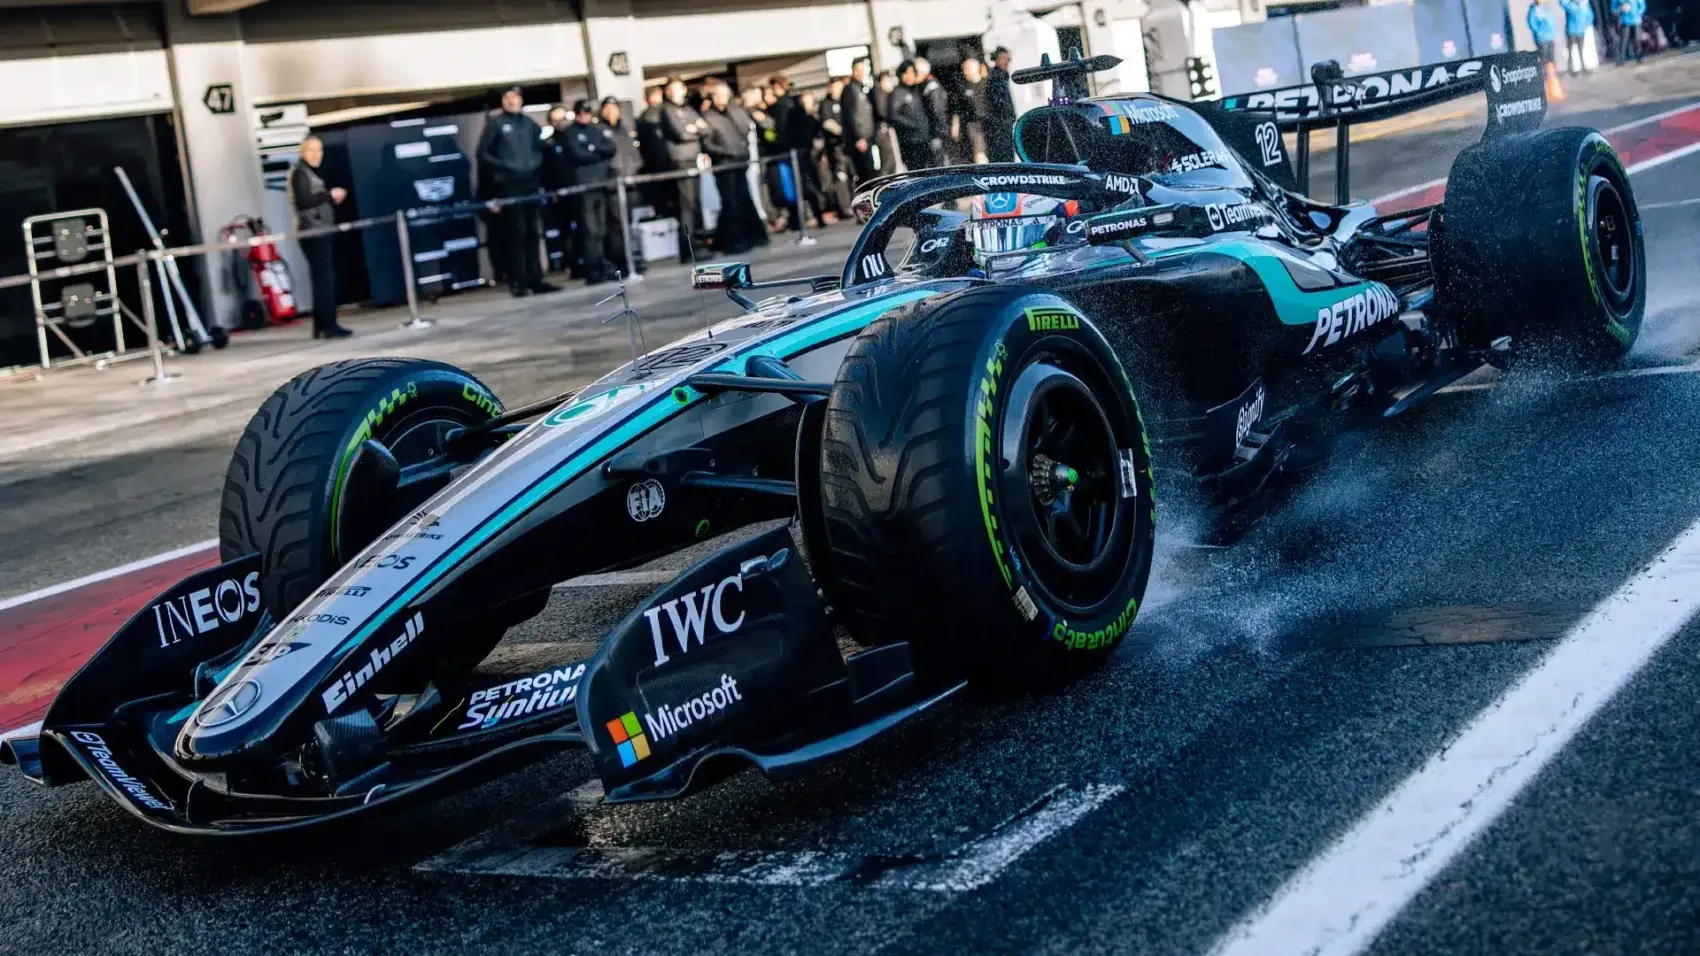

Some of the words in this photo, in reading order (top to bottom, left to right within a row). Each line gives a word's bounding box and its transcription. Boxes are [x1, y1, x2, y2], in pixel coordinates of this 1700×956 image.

[1123, 103, 1180, 125] Microsoft
[1255, 121, 1283, 166] 12
[979, 175, 1065, 186] CROWDSTRIKE
[1106, 175, 1131, 193] AMD
[1091, 217, 1147, 236] PETRONAS
[1024, 305, 1080, 331] PIRELLI
[629, 485, 664, 517] FIA
[152, 571, 260, 648] INEOS
[644, 573, 745, 667] IWC
[1053, 598, 1137, 650] Cinturato
[321, 611, 424, 714] Einhell
[469, 663, 586, 705] PETRONA
[644, 673, 742, 741] Microsoft
[86, 744, 175, 810] TeamViewer
